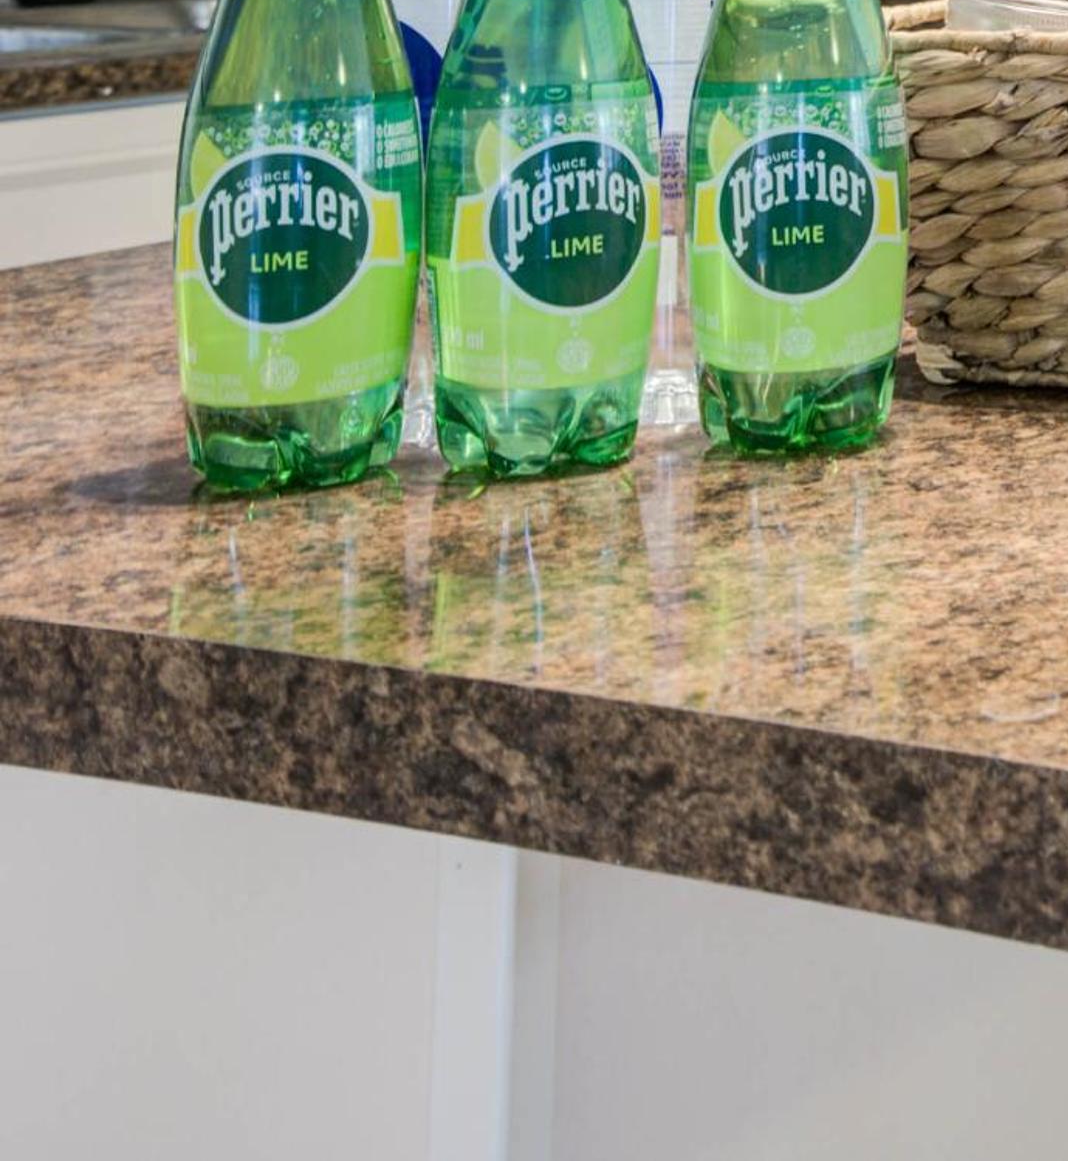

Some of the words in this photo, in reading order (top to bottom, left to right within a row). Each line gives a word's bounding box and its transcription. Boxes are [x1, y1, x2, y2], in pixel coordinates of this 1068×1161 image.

[757, 149, 806, 170] OURCE
[551, 234, 604, 259] LIME
[771, 225, 825, 247] LIME
[250, 250, 309, 273] LIME
